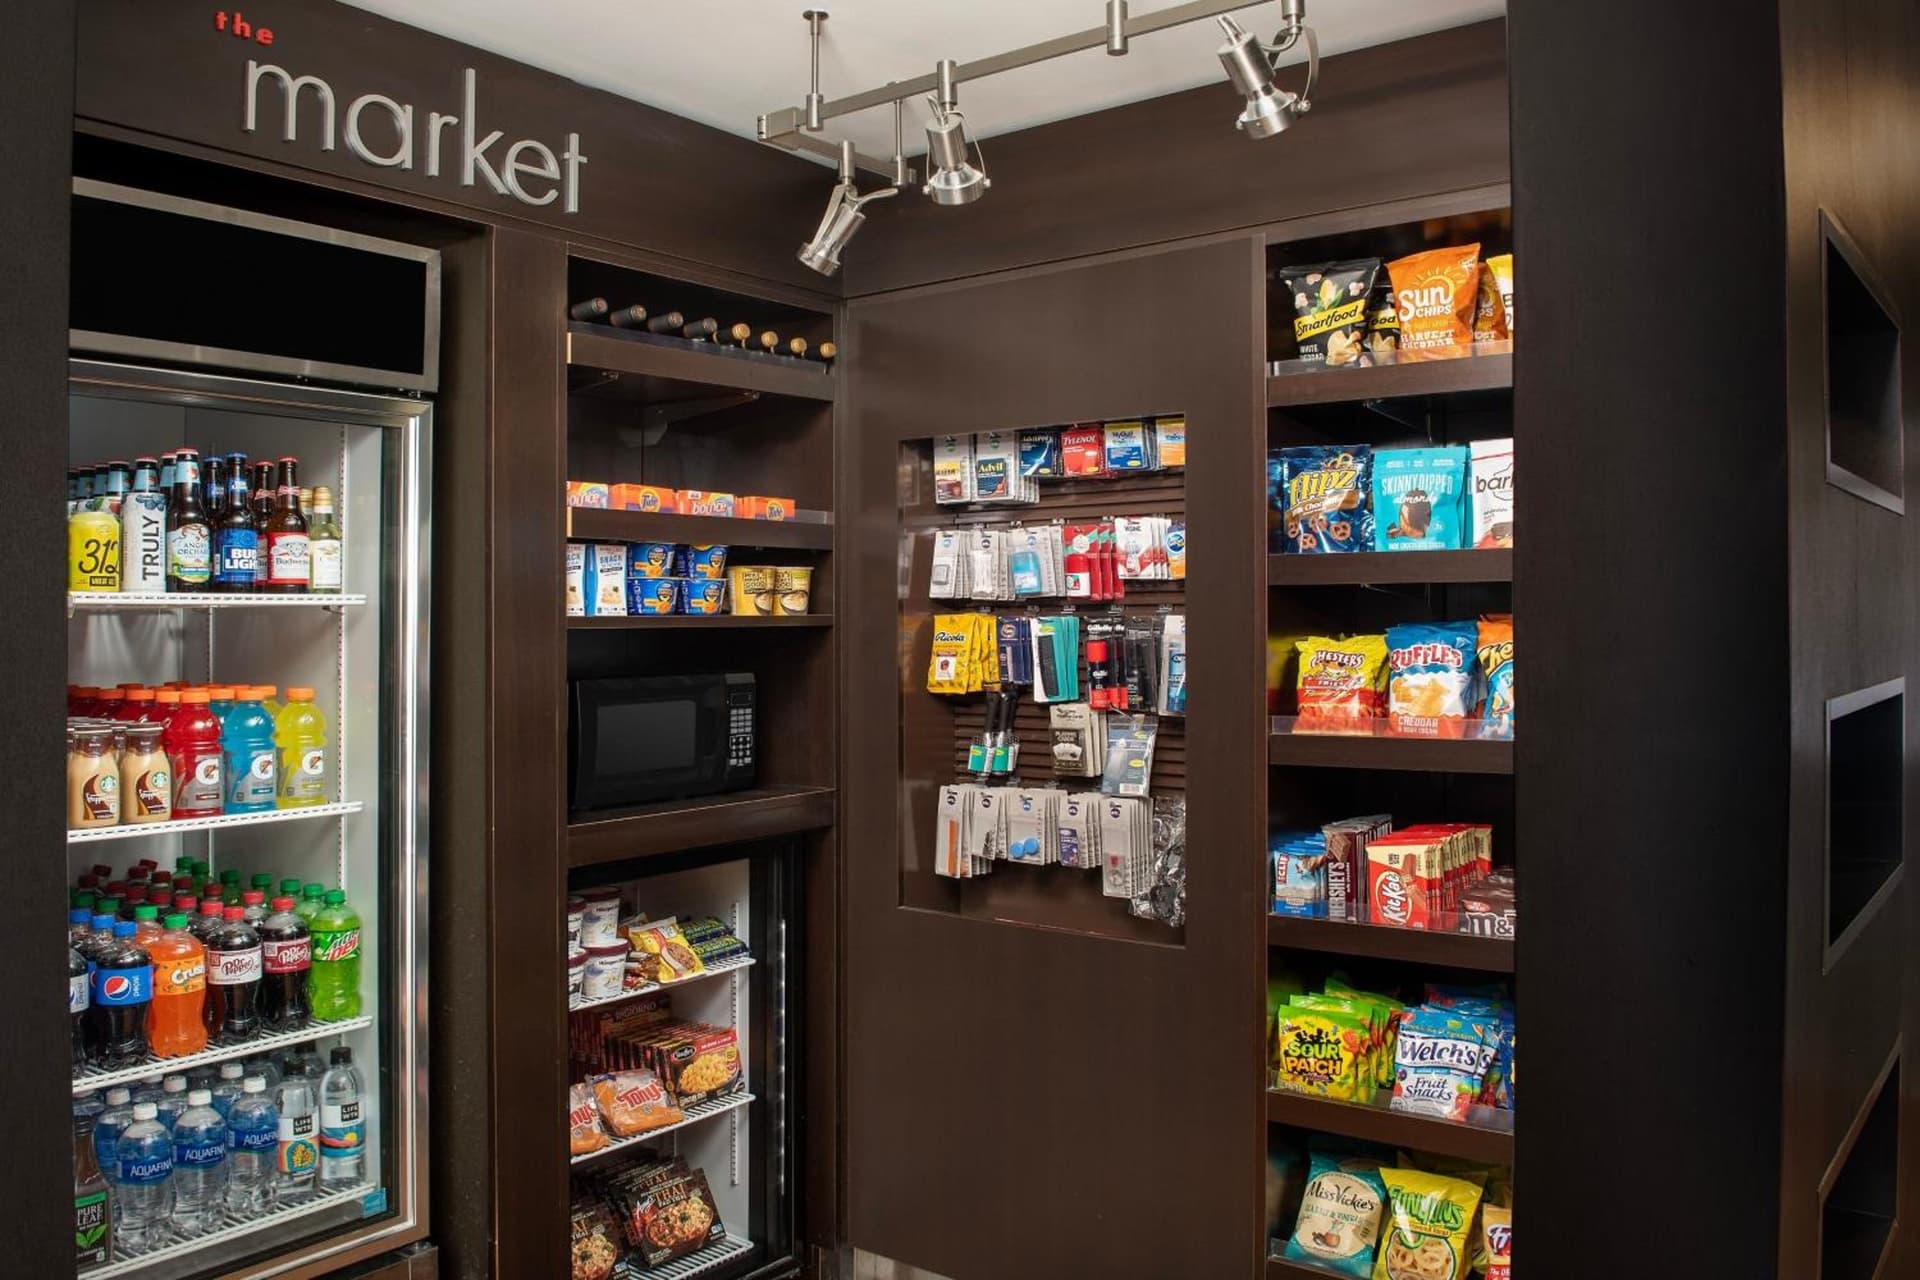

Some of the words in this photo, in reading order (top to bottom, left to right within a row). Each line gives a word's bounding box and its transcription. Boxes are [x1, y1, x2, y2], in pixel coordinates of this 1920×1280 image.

[214, 11, 275, 45] the
[242, 60, 589, 214] market
[1398, 283, 1454, 322] Sun
[1415, 305, 1452, 318] CHIPS
[1296, 305, 1359, 337] Smartfood
[979, 462, 1003, 473] Advil
[692, 500, 727, 513] bounce
[142, 515, 160, 580] TRULY
[935, 632, 965, 642] Ricola
[1391, 644, 1462, 672] RUFFLES
[1328, 862, 1346, 918] HERSHEY'S
[1288, 1040, 1339, 1060] SOUR
[1400, 1040, 1476, 1066] Welch's
[1286, 1057, 1342, 1076] PATCH
[1404, 1085, 1453, 1101] Snacks
[1415, 1077, 1448, 1089] Fruit
[1306, 1181, 1336, 1200] Miss
[1334, 1184, 1375, 1214] Vickie's
[78, 1203, 103, 1217] PURE
